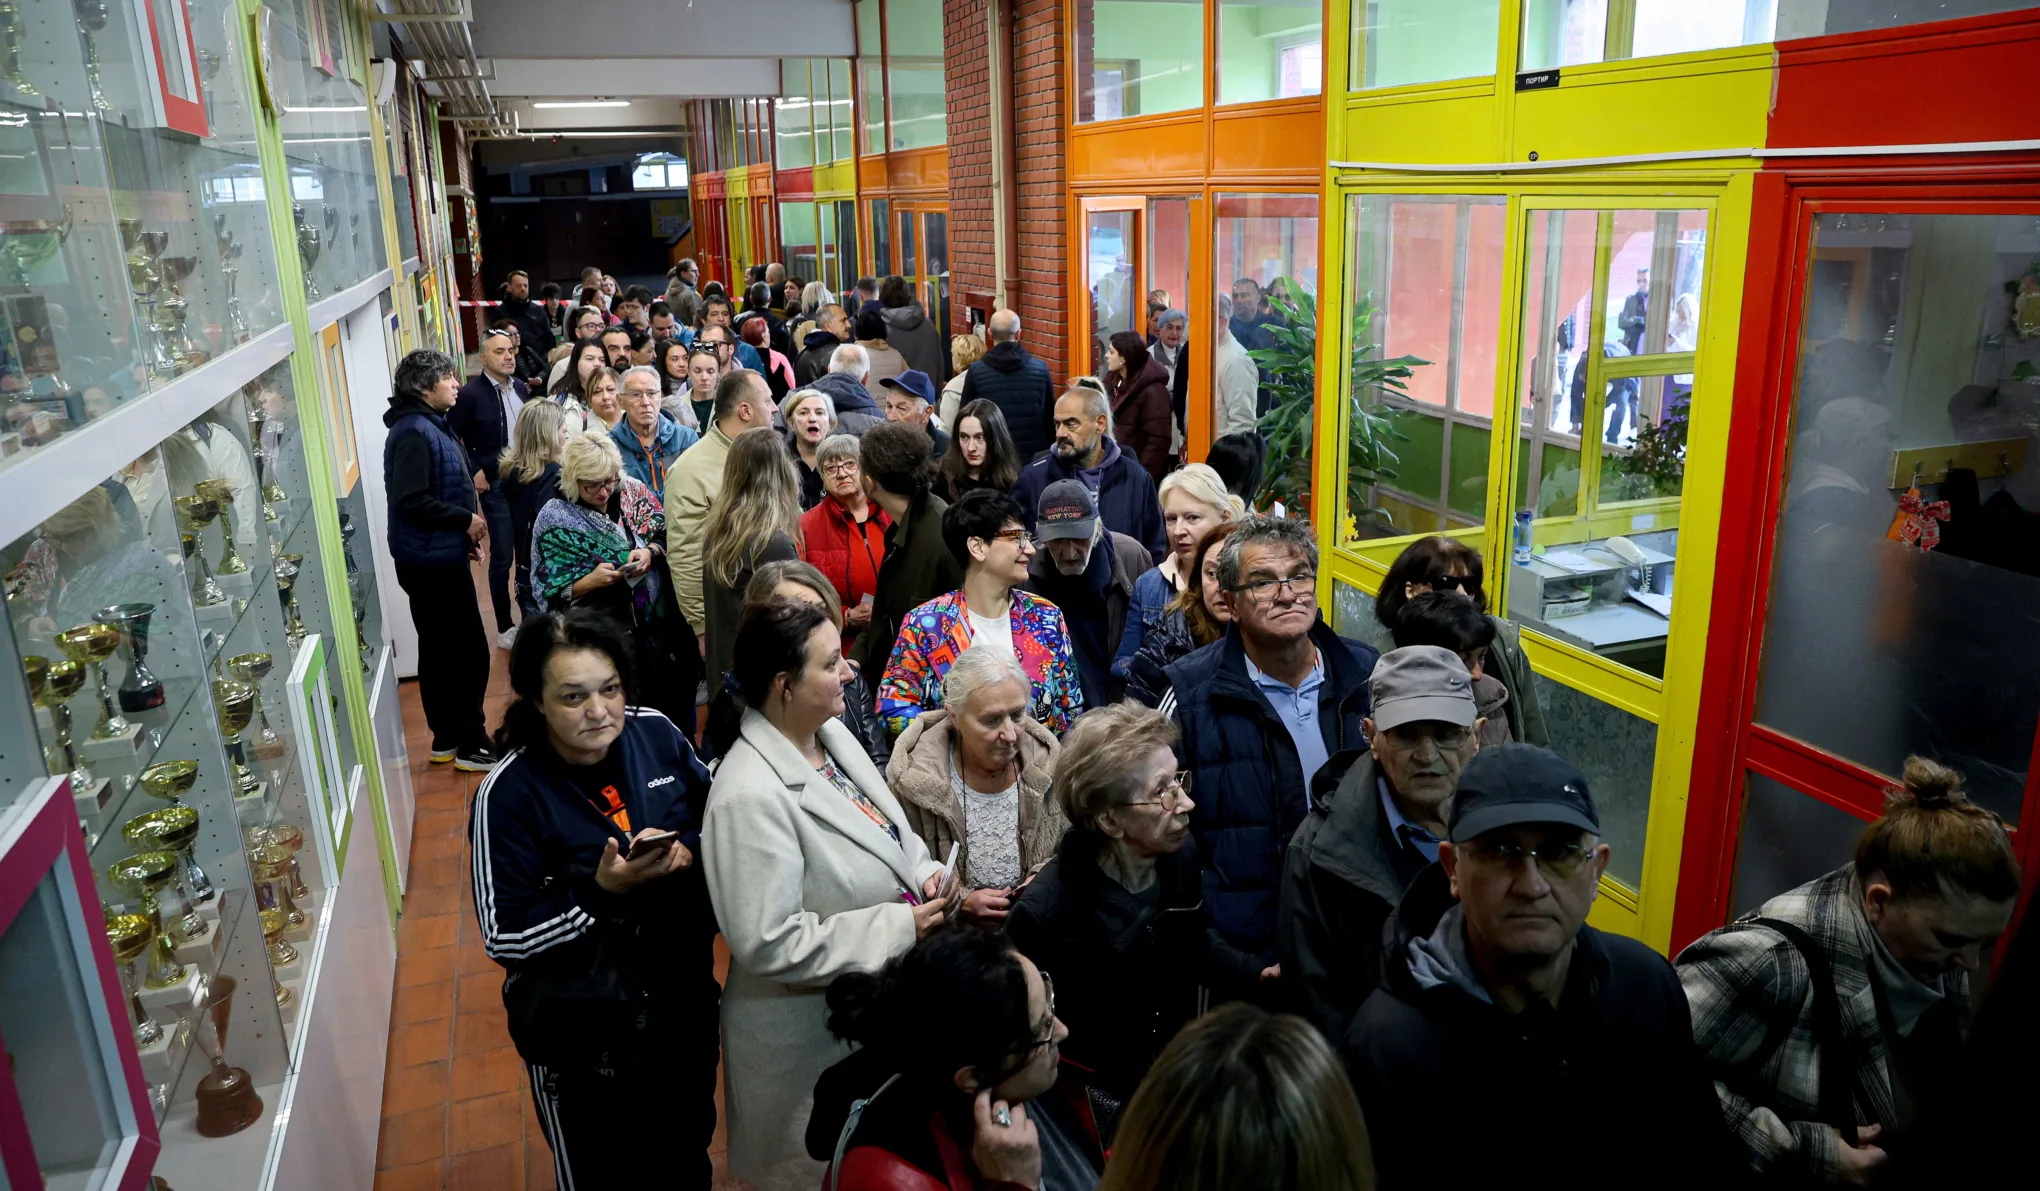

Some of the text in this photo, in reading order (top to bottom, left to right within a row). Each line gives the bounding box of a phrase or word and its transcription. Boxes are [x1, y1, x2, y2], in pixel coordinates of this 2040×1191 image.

[1525, 75, 1549, 85] ПОРТИР
[1047, 513, 1062, 521] NEW
[647, 775, 675, 788] adidas
